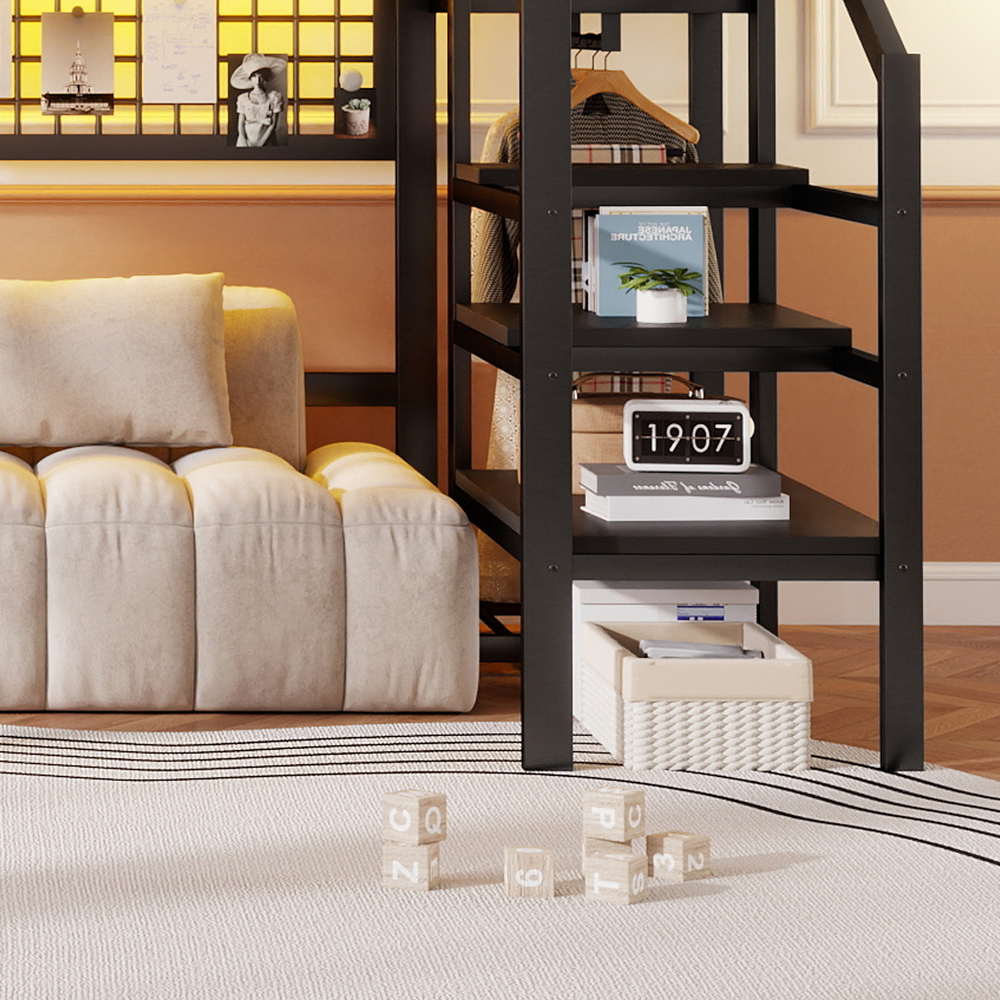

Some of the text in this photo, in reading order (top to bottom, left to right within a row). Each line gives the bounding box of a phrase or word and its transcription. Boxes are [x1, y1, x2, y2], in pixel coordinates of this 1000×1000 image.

[648, 423, 732, 452] 1907
[424, 806, 442, 835] Q
[593, 872, 620, 894] T
